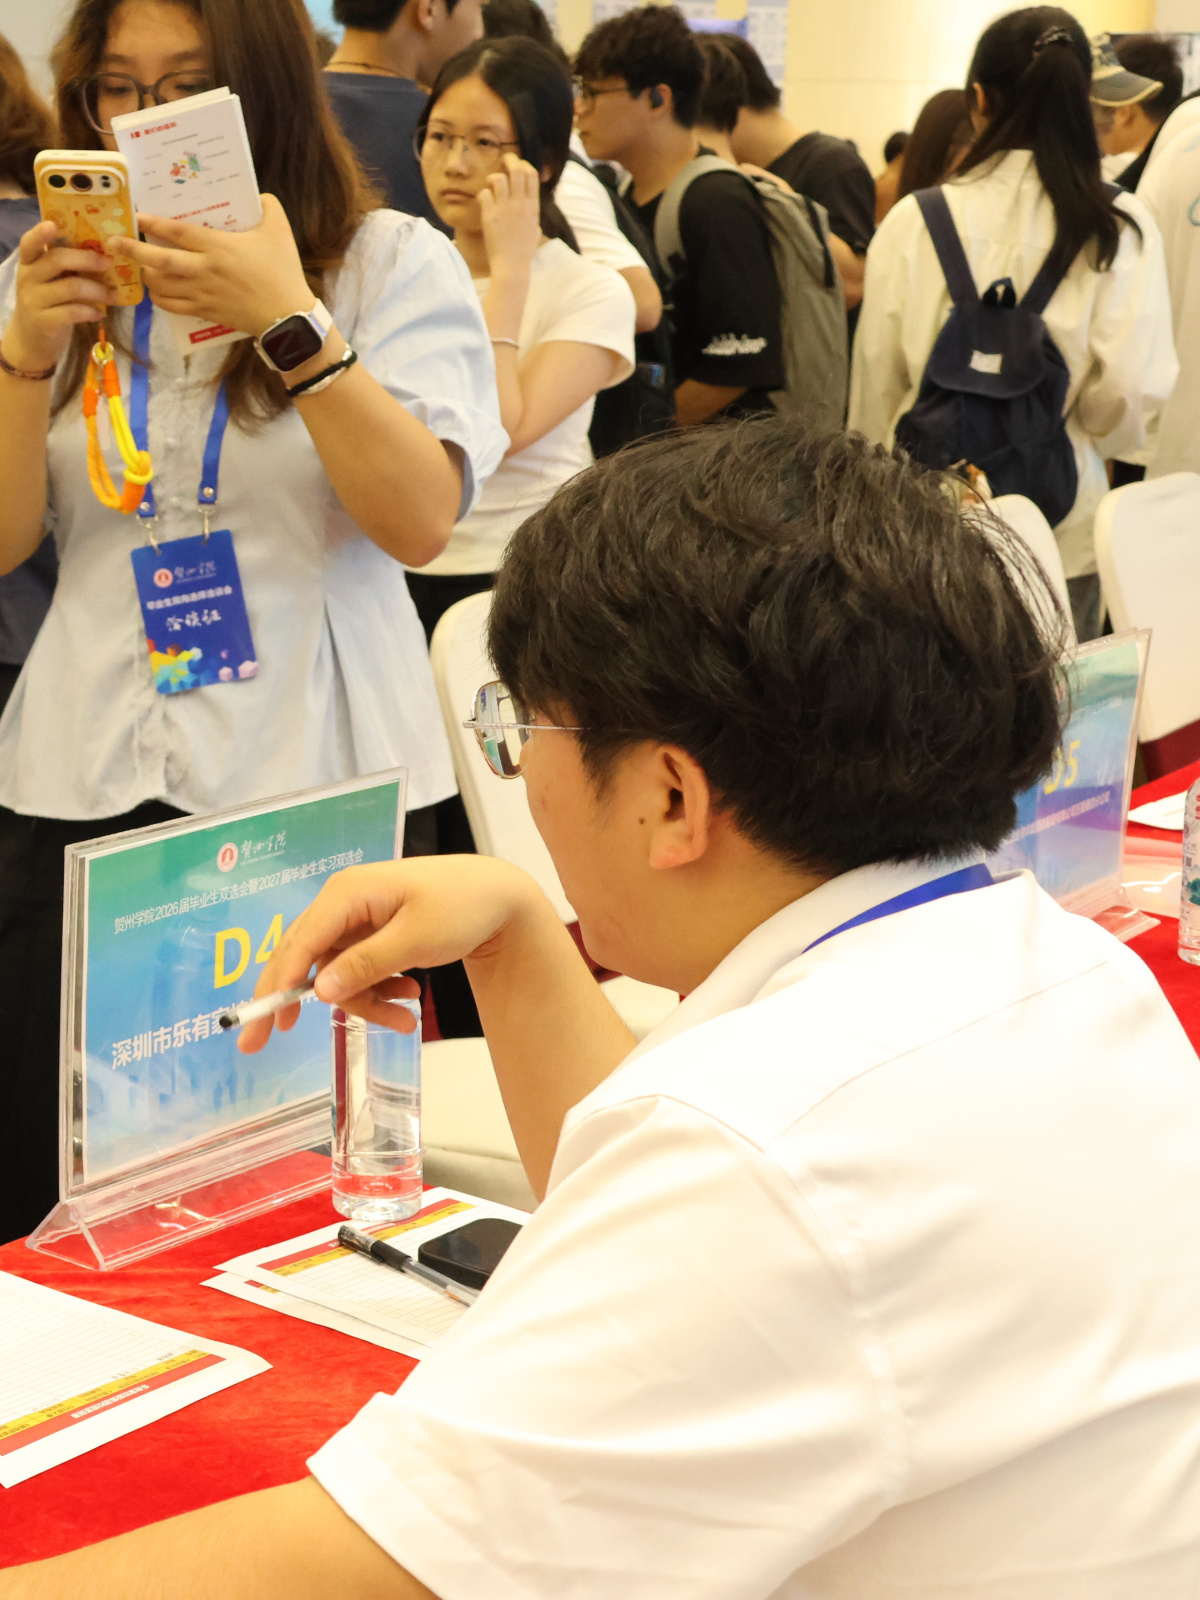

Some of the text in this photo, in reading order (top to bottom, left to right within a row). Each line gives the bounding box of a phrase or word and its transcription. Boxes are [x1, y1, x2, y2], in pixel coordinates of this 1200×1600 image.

[114, 848, 365, 934] 贺州学院2026届毕业生双选会暨2027届毕业生实习双选会
[111, 997, 255, 1070] 深圳市乐有家
